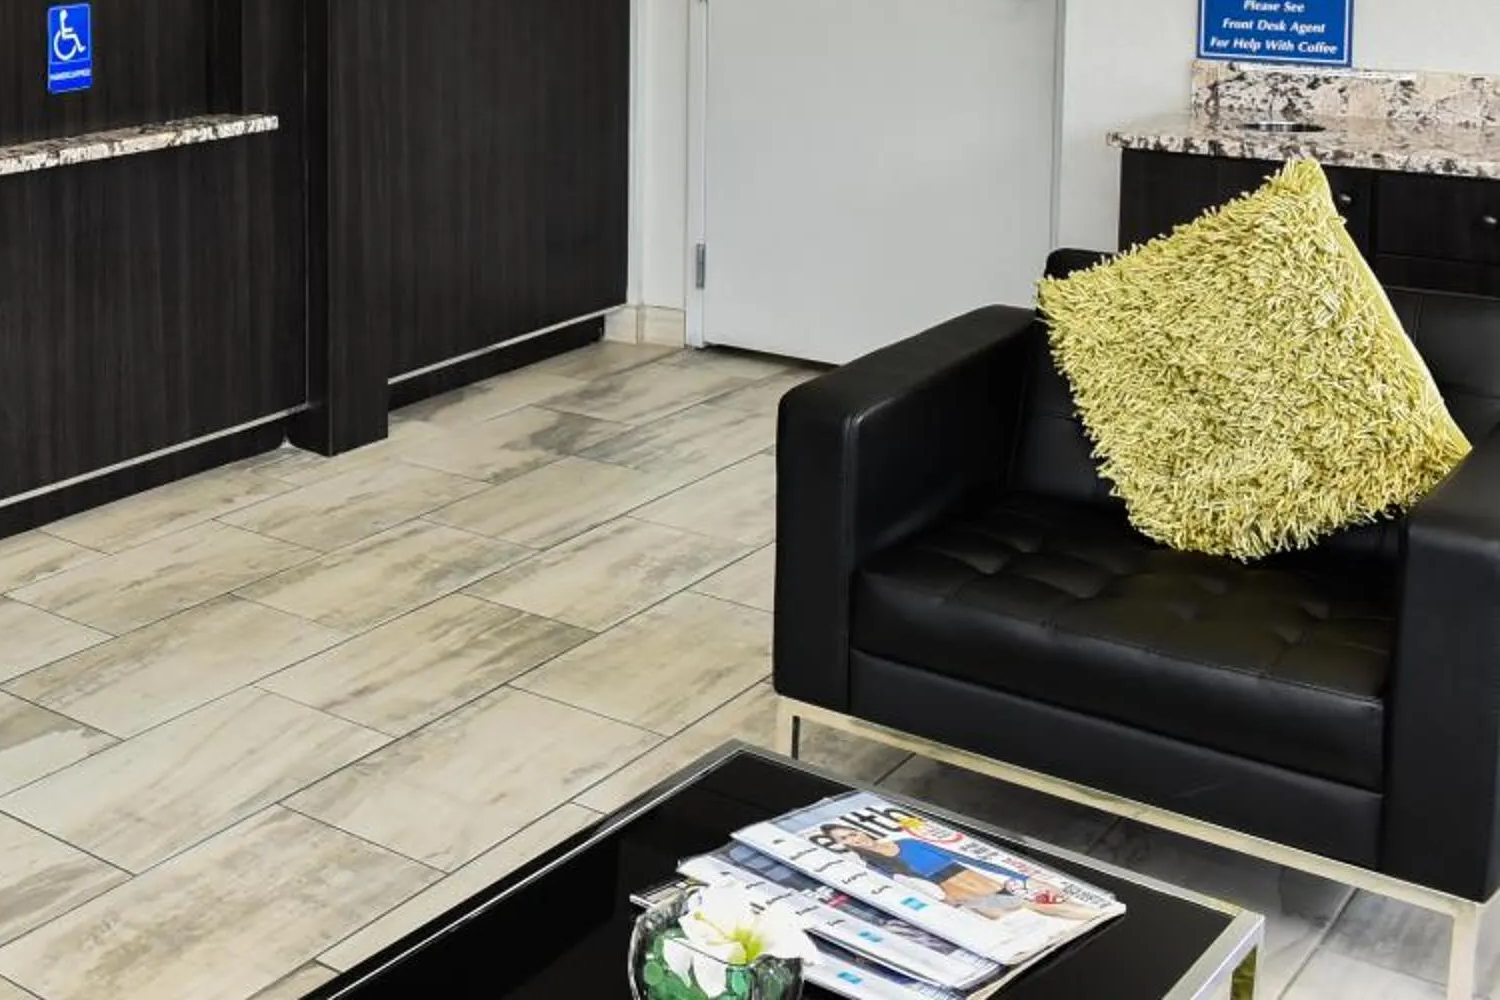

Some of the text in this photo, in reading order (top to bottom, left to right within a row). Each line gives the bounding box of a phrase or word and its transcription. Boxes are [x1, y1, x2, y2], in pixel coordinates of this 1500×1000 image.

[1243, 0, 1305, 13] Please See
[1222, 18, 1325, 36] Front Desk Agent
[1210, 36, 1338, 55] For Help With Coffee
[809, 806, 923, 854] elth
